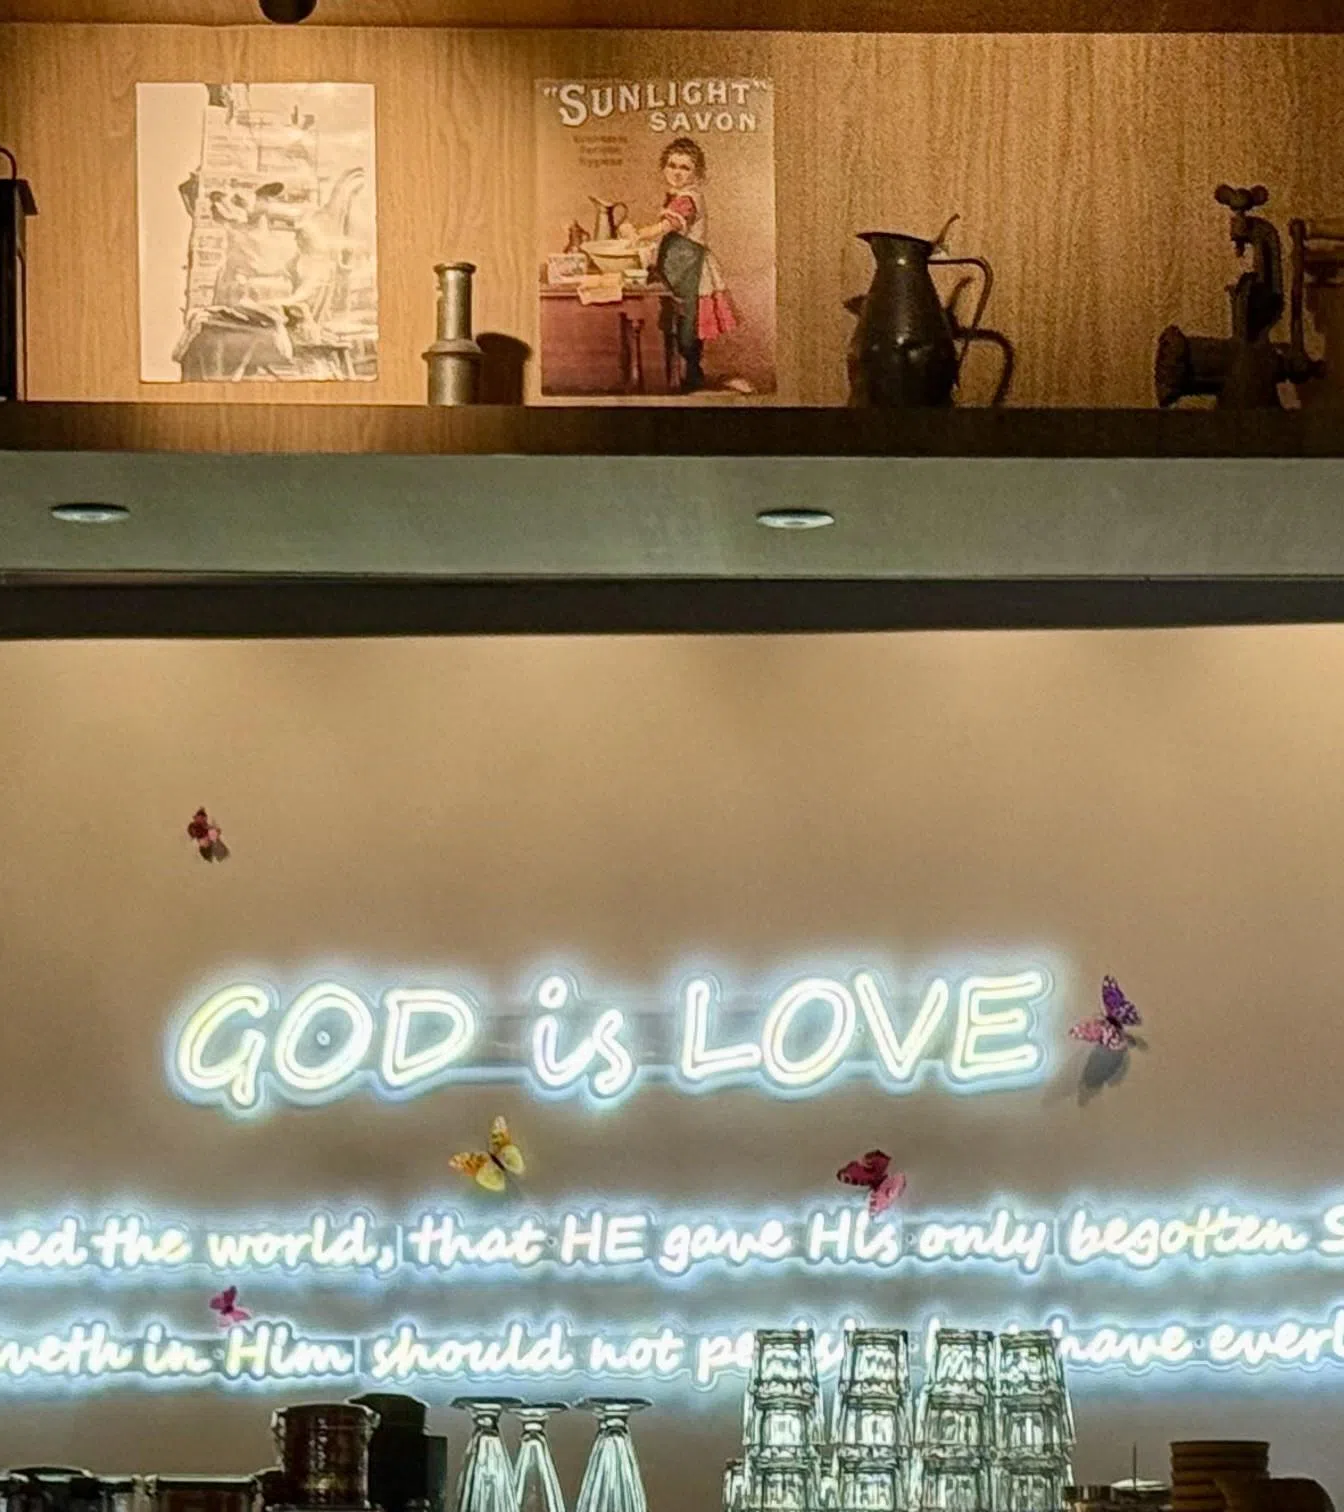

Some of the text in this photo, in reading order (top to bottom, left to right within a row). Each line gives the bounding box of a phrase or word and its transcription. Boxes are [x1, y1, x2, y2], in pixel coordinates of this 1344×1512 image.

[649, 112, 757, 133] SAVON
[178, 971, 1051, 1108] GOD is LOVE
[93, 1215, 192, 1264] the
[207, 1216, 395, 1270] world,
[409, 1212, 548, 1265] that
[561, 1211, 647, 1264] HE
[657, 1220, 792, 1273] gave
[808, 1210, 899, 1261] His
[918, 1210, 1047, 1270] only
[1068, 1207, 1308, 1265] begotten
[142, 1324, 212, 1373] in
[224, 1323, 353, 1379] Him
[370, 1321, 575, 1380] should
[589, 1327, 686, 1370] not
